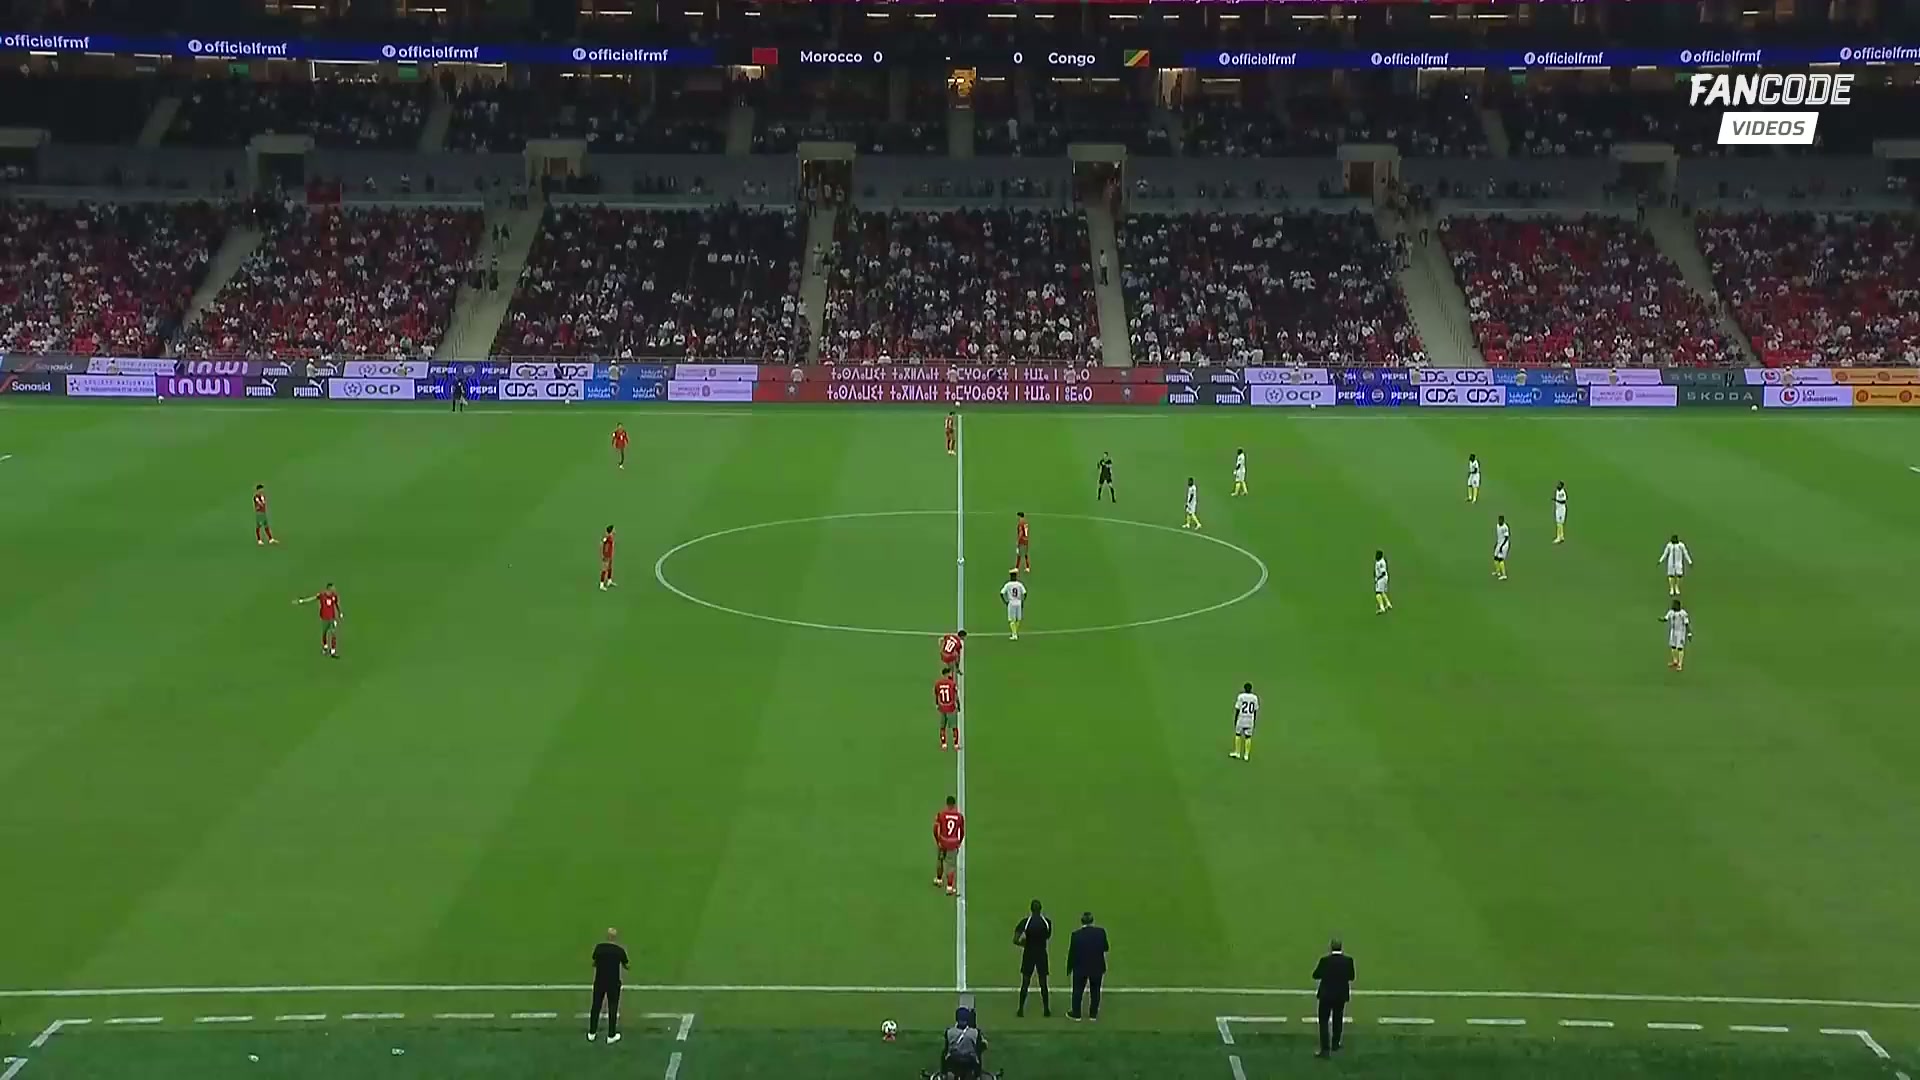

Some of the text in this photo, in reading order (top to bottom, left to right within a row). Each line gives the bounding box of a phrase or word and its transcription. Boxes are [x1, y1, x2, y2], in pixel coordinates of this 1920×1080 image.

[800, 50, 883, 63] Morocco 0
[1013, 52, 1096, 67] 0 Congo
[430, 367, 457, 375] PEPSI
[482, 367, 508, 375] PEPSI
[1279, 372, 1313, 381] OP
[1381, 373, 1408, 381] PEPSI
[1456, 371, 1488, 383] CDG
[11, 381, 51, 391] Sonasid
[364, 385, 401, 395] OCP
[417, 385, 444, 394] PEPSI
[469, 385, 497, 394] PEPSI
[504, 382, 538, 397] CDG
[546, 382, 579, 397] CDG
[246, 386, 272, 397] PUMA
[293, 387, 319, 397] PUMA
[1286, 391, 1321, 400] OCP
[1338, 392, 1365, 400] PEPSI
[1391, 392, 1418, 400] PEPSI
[1425, 388, 1458, 403] CDG
[1467, 388, 1500, 403] CDG
[1169, 393, 1194, 404] PUMA
[1215, 394, 1241, 404] PUMA
[1012, 587, 1018, 597] 9
[944, 639, 956, 653] 10
[939, 688, 949, 702] 11
[1241, 701, 1255, 714] 20
[947, 819, 955, 836] 9
